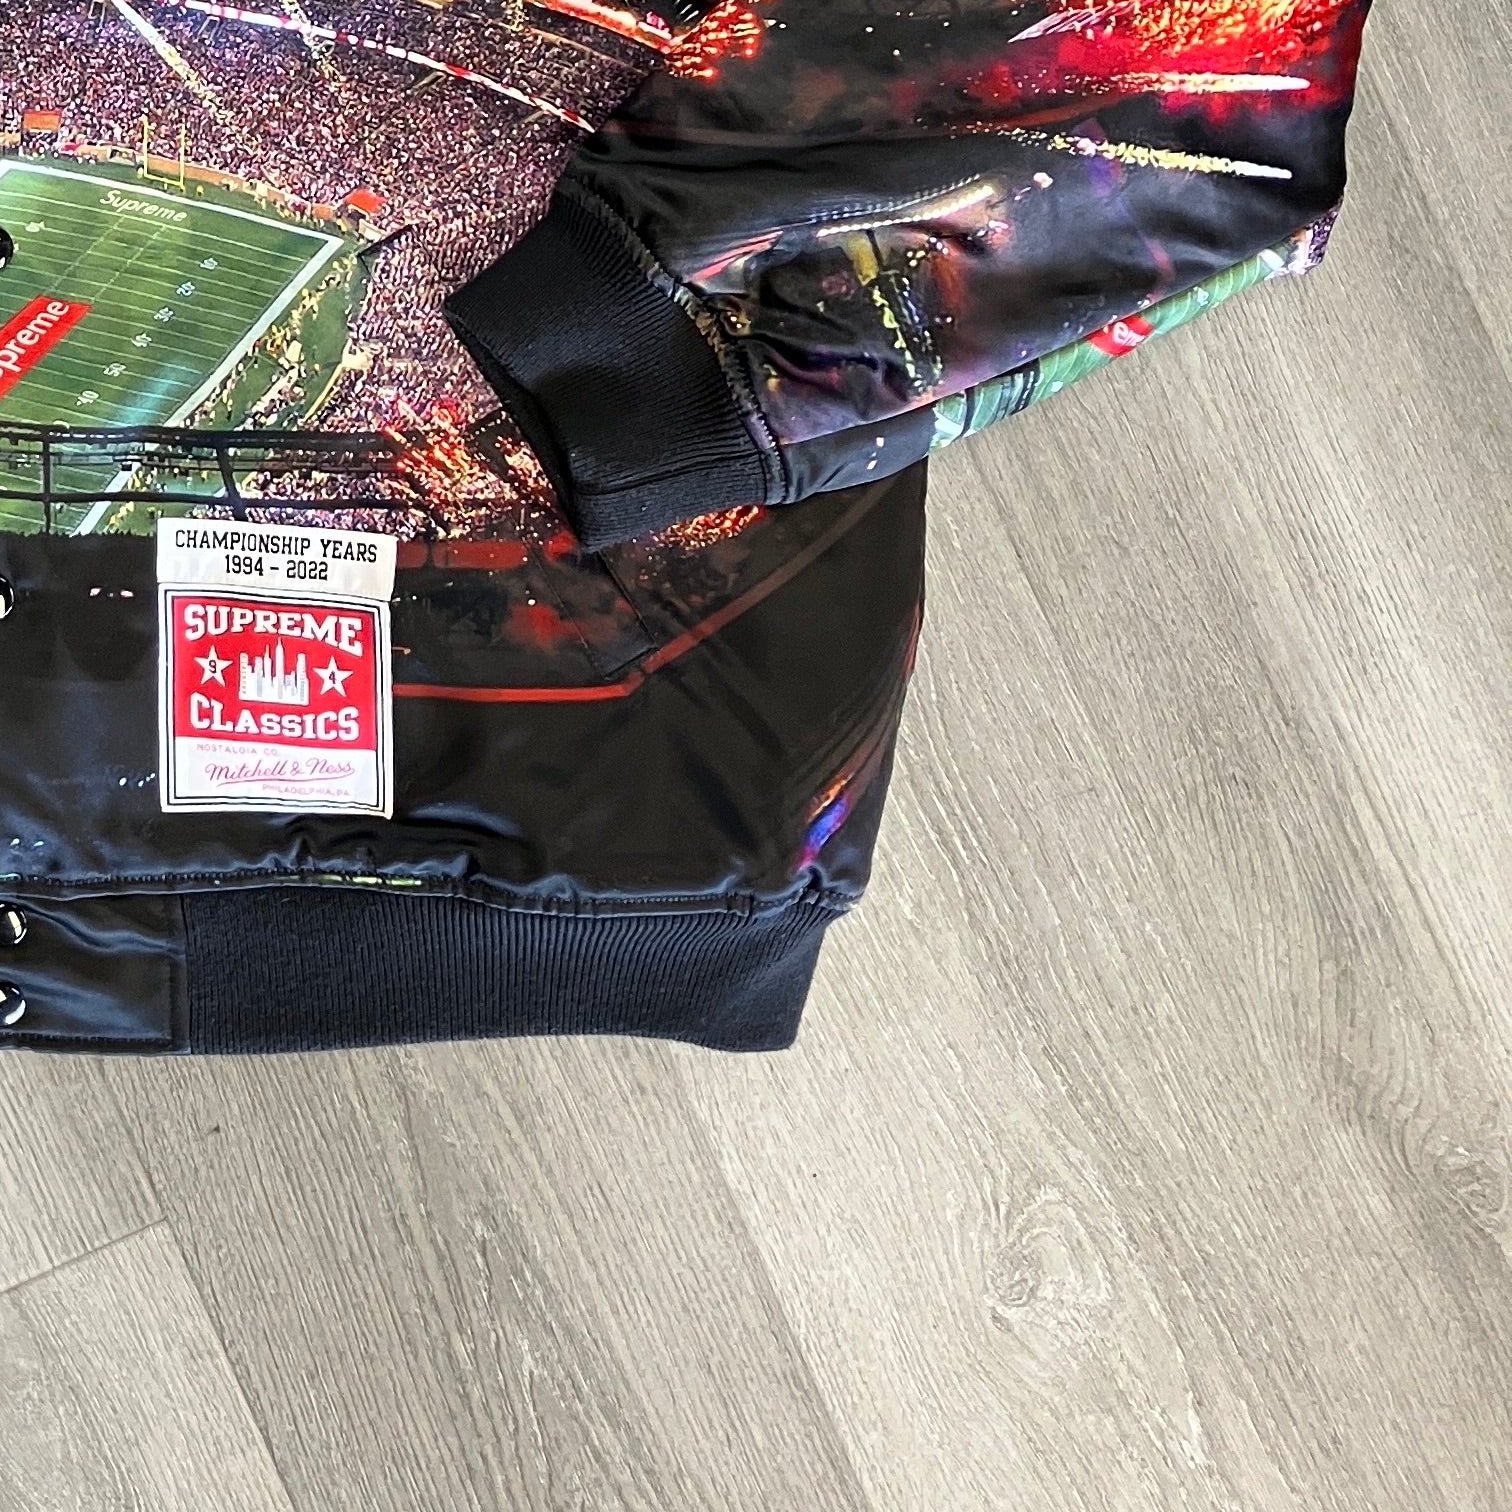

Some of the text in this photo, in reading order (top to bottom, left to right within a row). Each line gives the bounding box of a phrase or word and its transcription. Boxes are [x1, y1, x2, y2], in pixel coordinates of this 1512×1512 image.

[99, 189, 188, 222] Supreme
[175, 529, 378, 564] CHAMPIONSHIP YEARS
[225, 554, 264, 576] 1994
[286, 560, 329, 581] 2022
[184, 603, 364, 658] SUPREME
[208, 658, 337, 685] 9 4
[189, 691, 360, 742] CLASSICS
[205, 757, 355, 782] Mitchell & Ness
